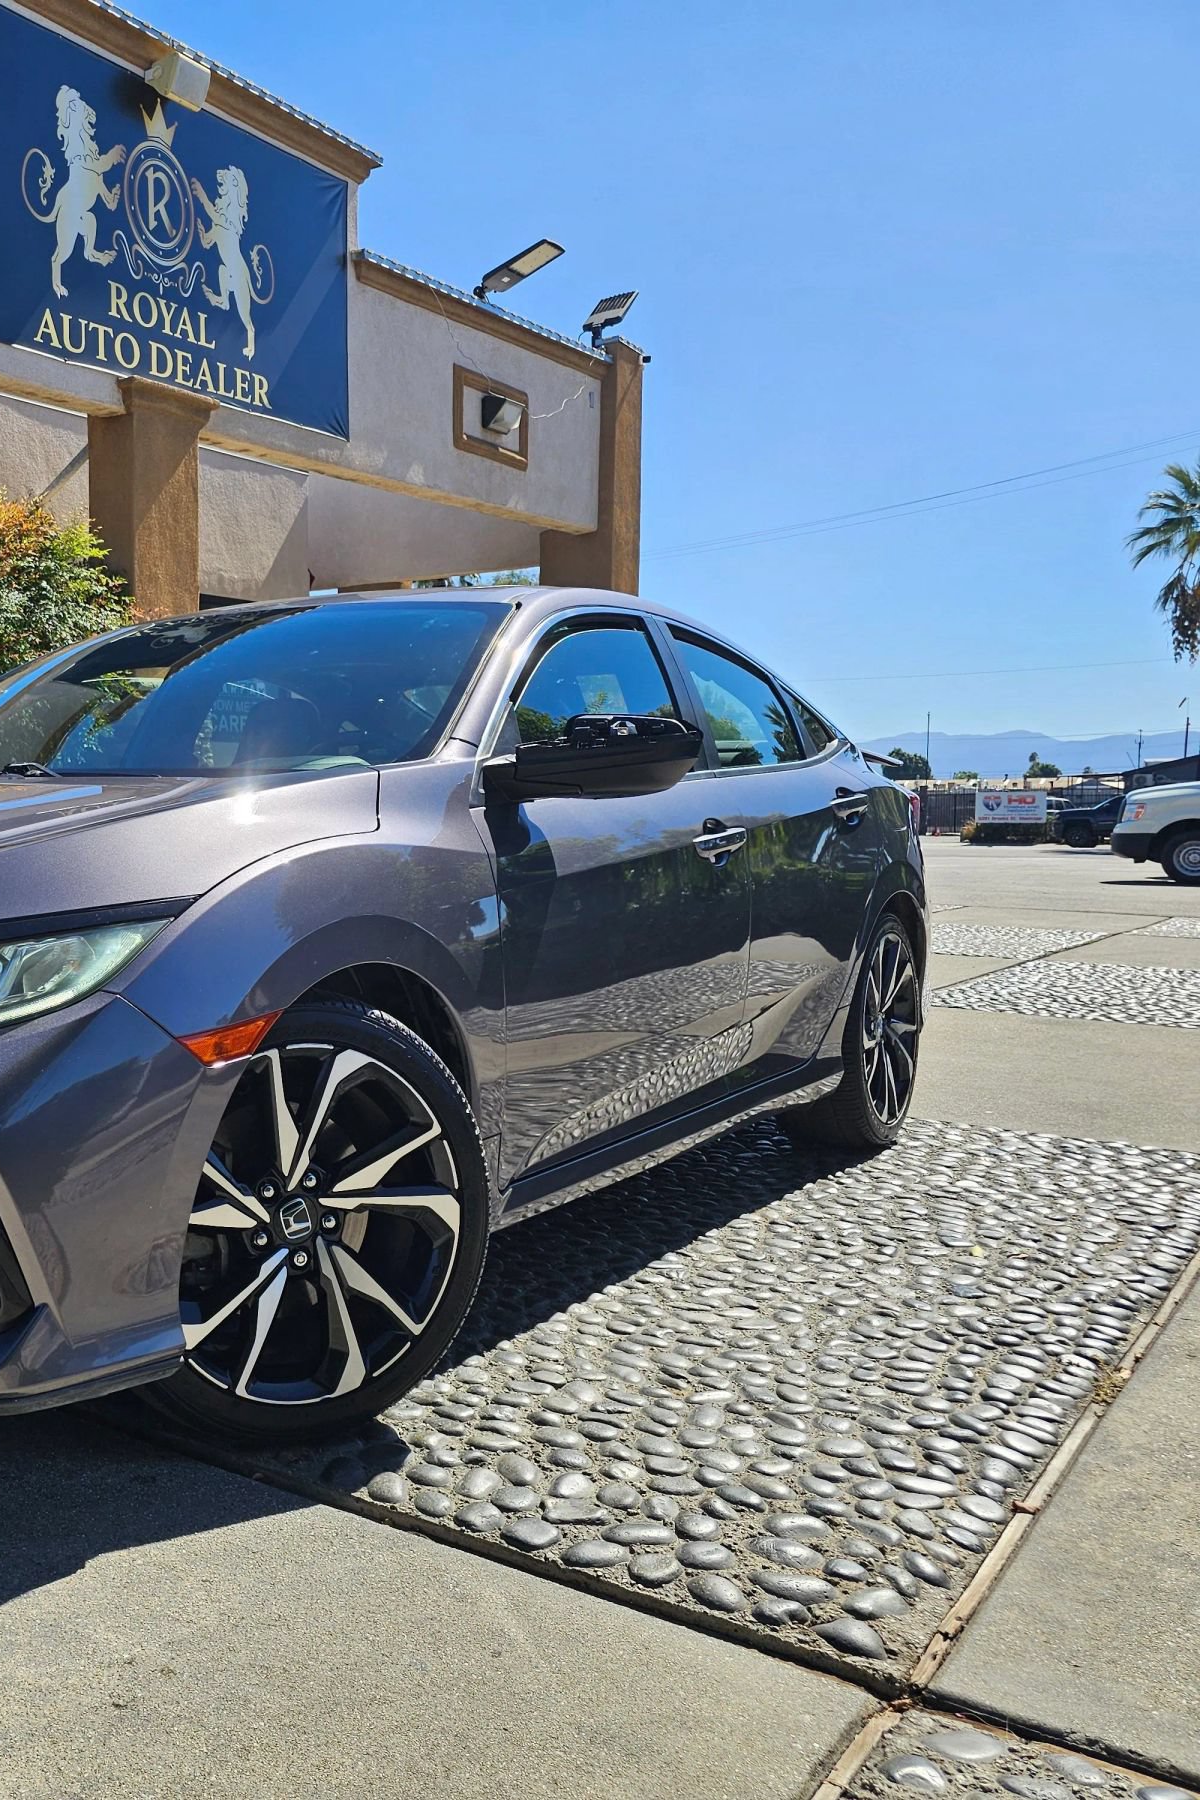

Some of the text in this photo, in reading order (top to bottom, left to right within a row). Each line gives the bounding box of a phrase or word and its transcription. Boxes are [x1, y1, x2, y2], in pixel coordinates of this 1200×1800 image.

[107, 280, 216, 350] ROYAL
[34, 308, 273, 409] AUTO DEALER
